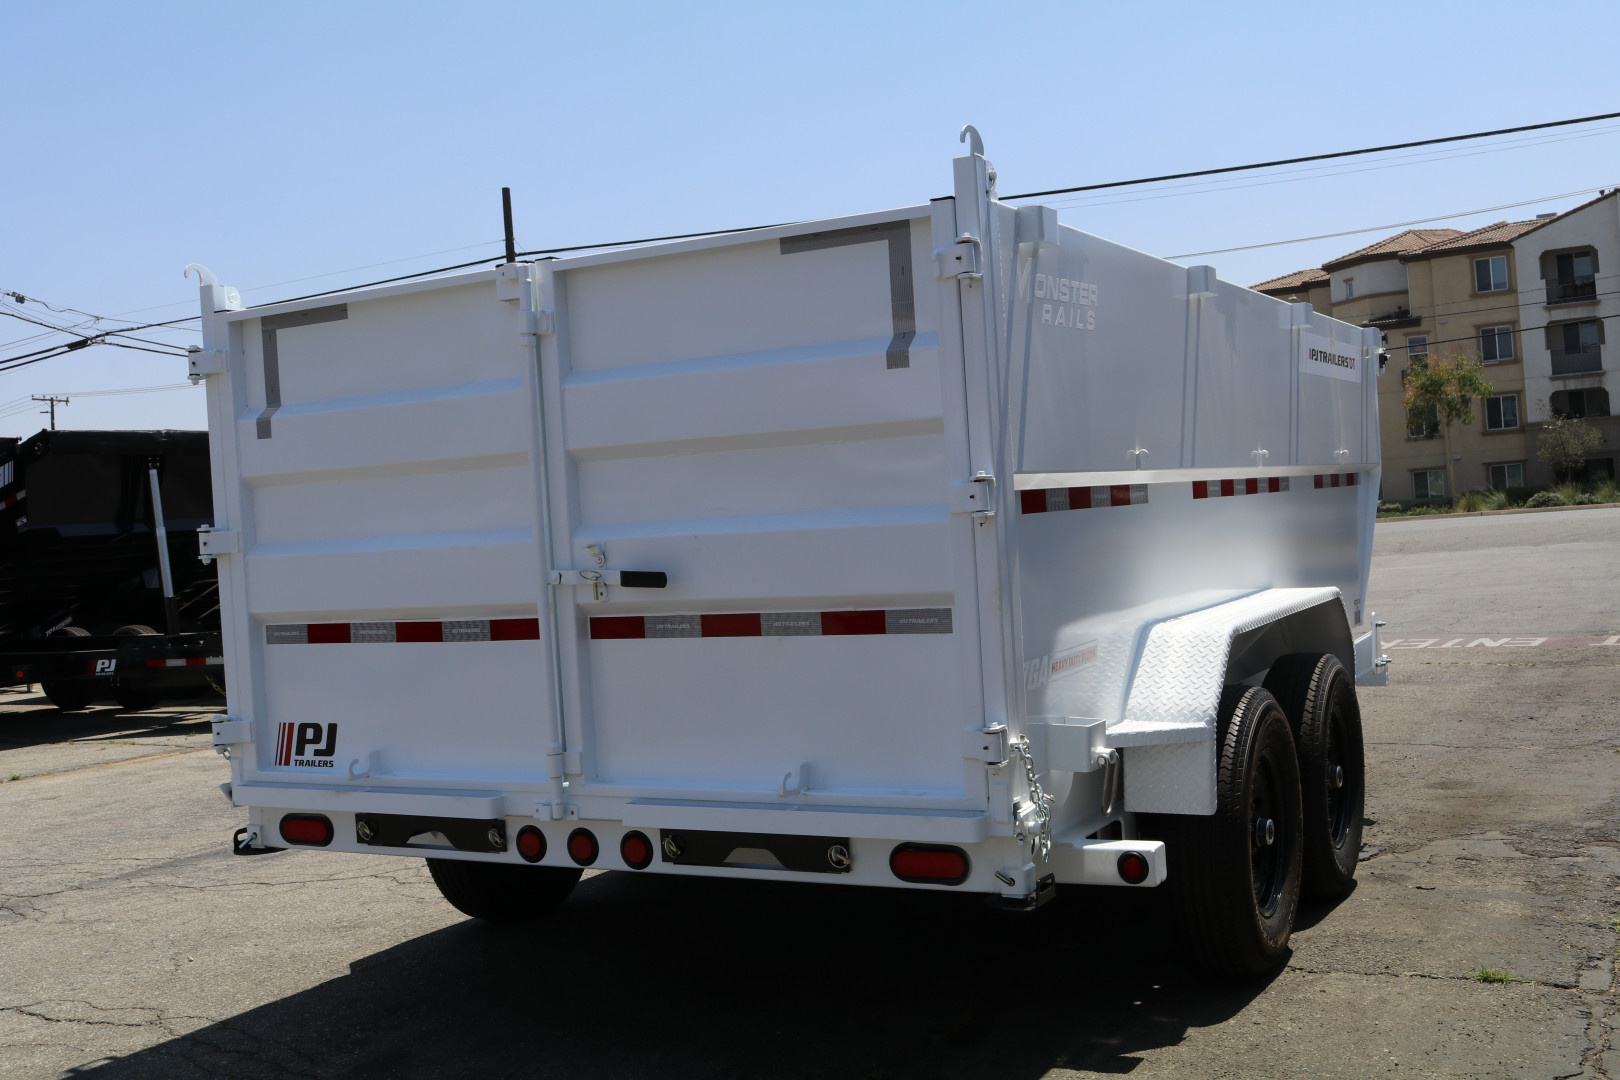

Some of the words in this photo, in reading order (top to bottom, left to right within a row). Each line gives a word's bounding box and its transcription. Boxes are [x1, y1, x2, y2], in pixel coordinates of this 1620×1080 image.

[1016, 255, 1098, 307] MONSTER
[1041, 303, 1096, 331] RAILS
[95, 658, 117, 672] PJ
[294, 722, 338, 757] PJ
[293, 759, 334, 768] TRAILERS
